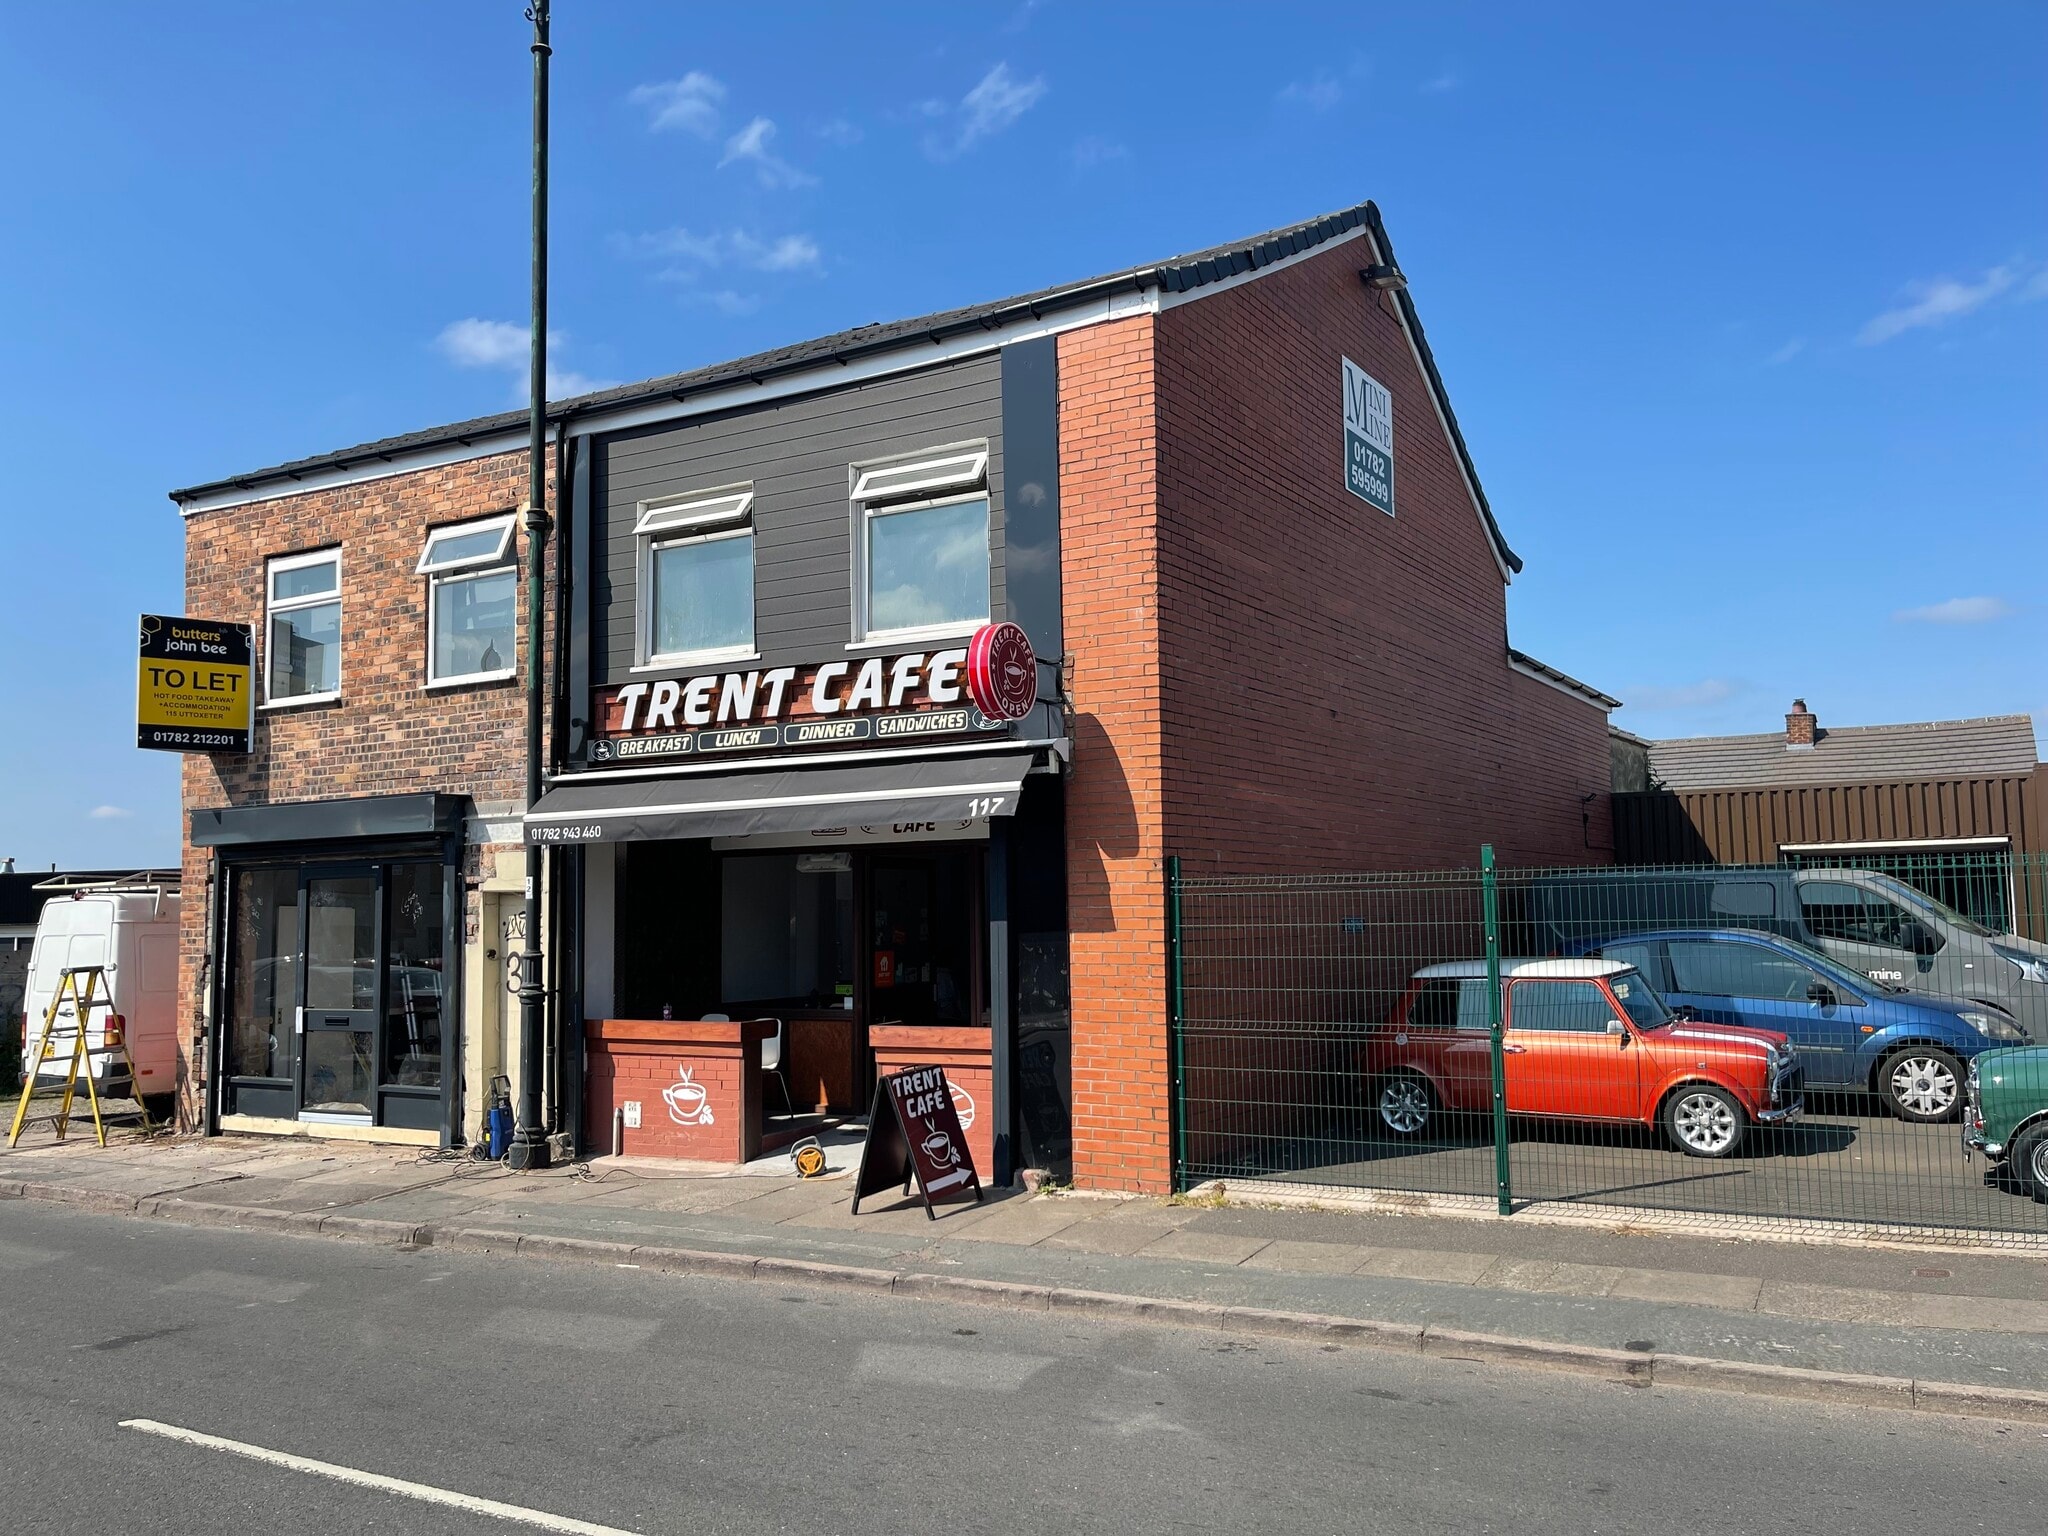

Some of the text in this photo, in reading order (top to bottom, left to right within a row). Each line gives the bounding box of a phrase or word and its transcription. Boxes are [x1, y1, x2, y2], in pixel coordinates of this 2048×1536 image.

[1345, 365, 1387, 435] MINI
[1353, 441, 1385, 478] 01782
[1351, 465, 1388, 503] 595999
[165, 638, 227, 655] john bee
[172, 626, 221, 642] butters
[992, 627, 1034, 665] TRENT CAFE
[148, 667, 242, 692] TO LET
[616, 649, 967, 730] TRENT CAFE
[171, 693, 193, 701] FOOD
[195, 695, 235, 703] TAKEAWAY
[1002, 698, 1029, 716] OPEN
[179, 711, 224, 719] UTTOXETER
[153, 731, 234, 745] 01782 212201
[620, 713, 965, 755] BREAKFAST LUNCH DINNER SANDWICHES
[968, 797, 1005, 817] 117
[531, 825, 601, 840] 01782 943 460
[892, 1067, 942, 1098] TRENT
[906, 1086, 945, 1119] CAFÉ
